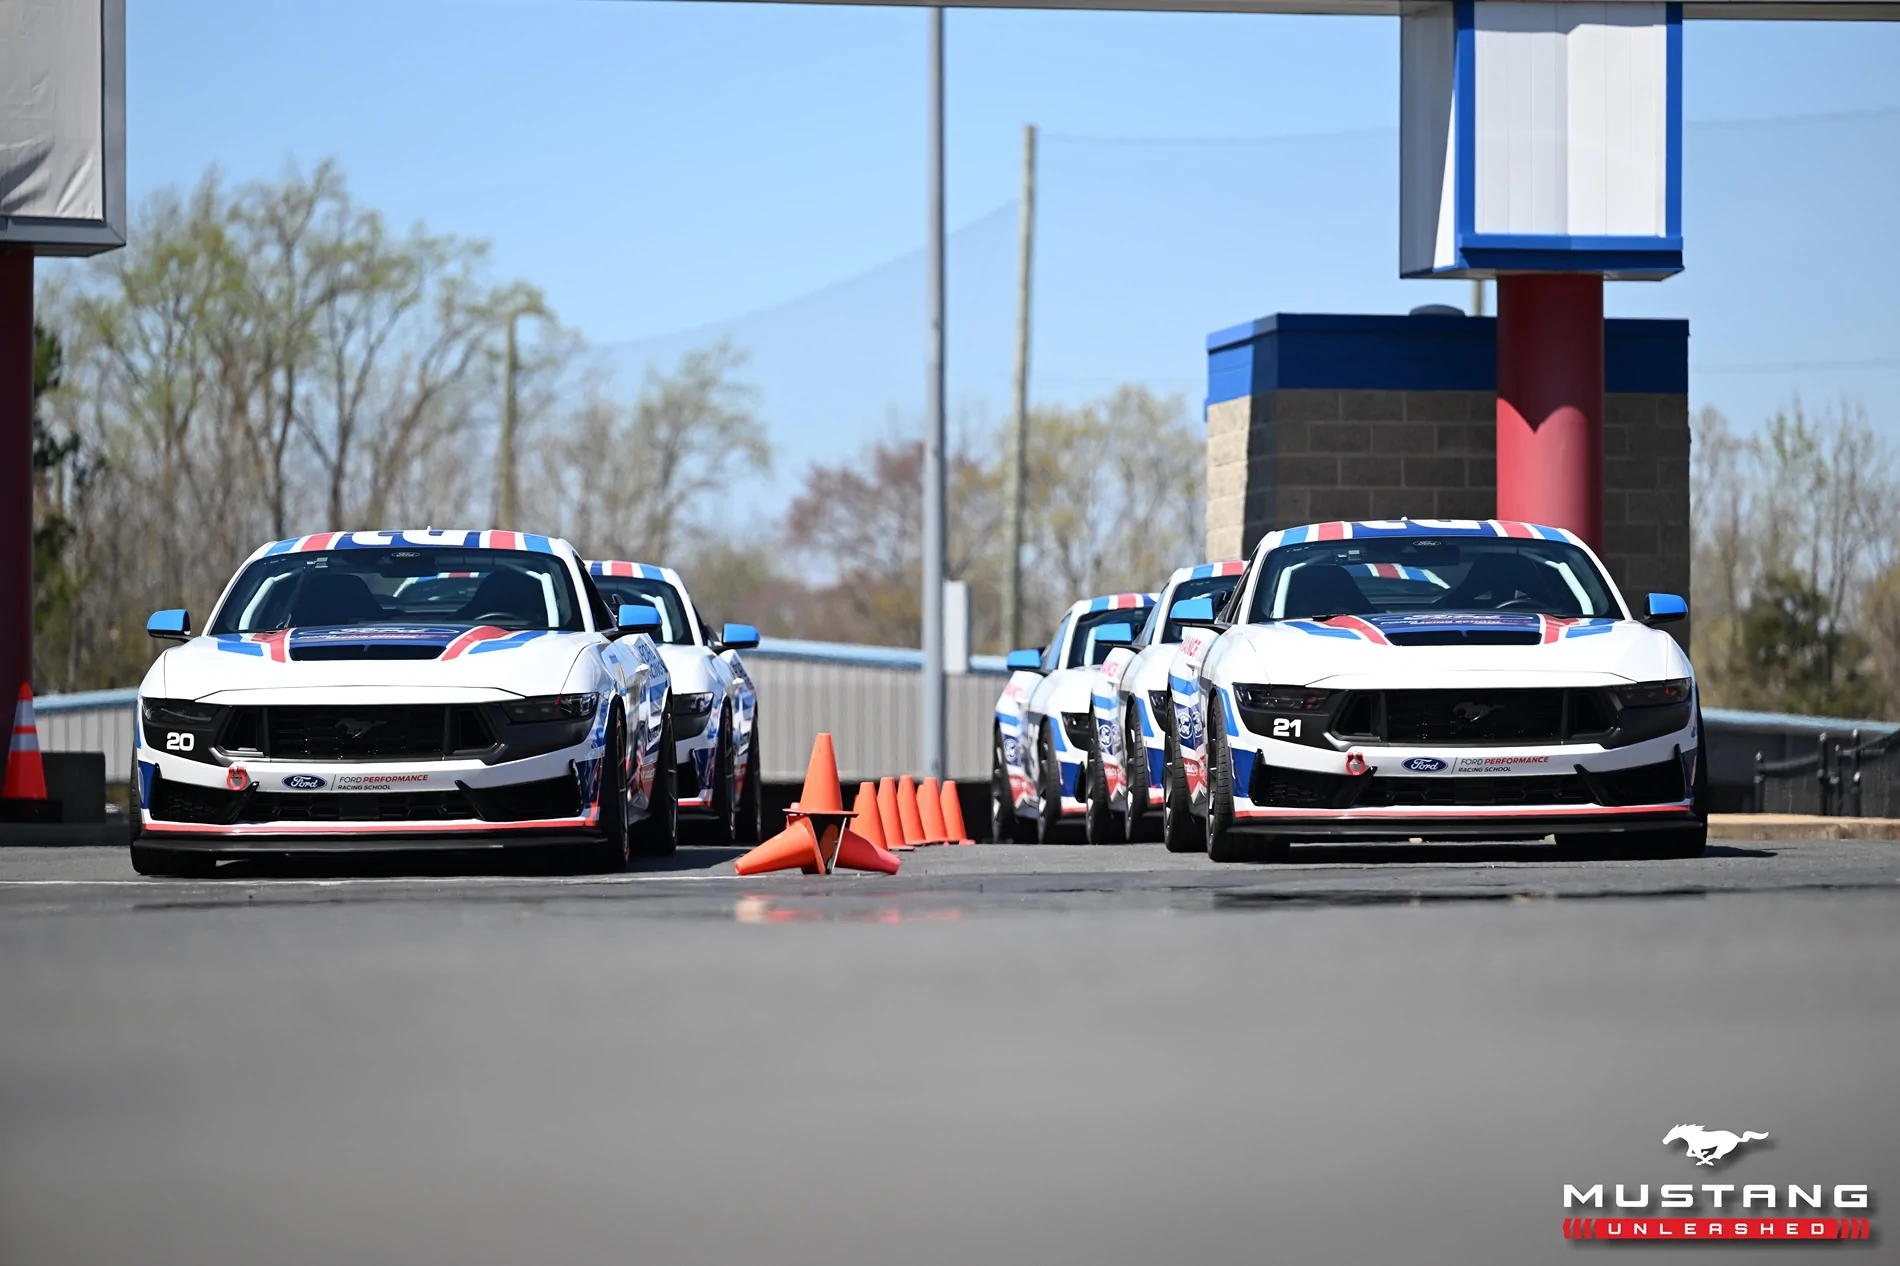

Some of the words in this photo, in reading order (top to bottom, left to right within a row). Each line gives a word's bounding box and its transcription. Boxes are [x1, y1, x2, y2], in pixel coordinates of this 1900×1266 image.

[1273, 718, 1301, 737] 21
[166, 732, 195, 751] 20
[1410, 758, 1438, 770] Ford
[1484, 756, 1549, 765] PERFORMANCE
[290, 775, 318, 788] Ford
[362, 774, 428, 783] PERFORMANCE
